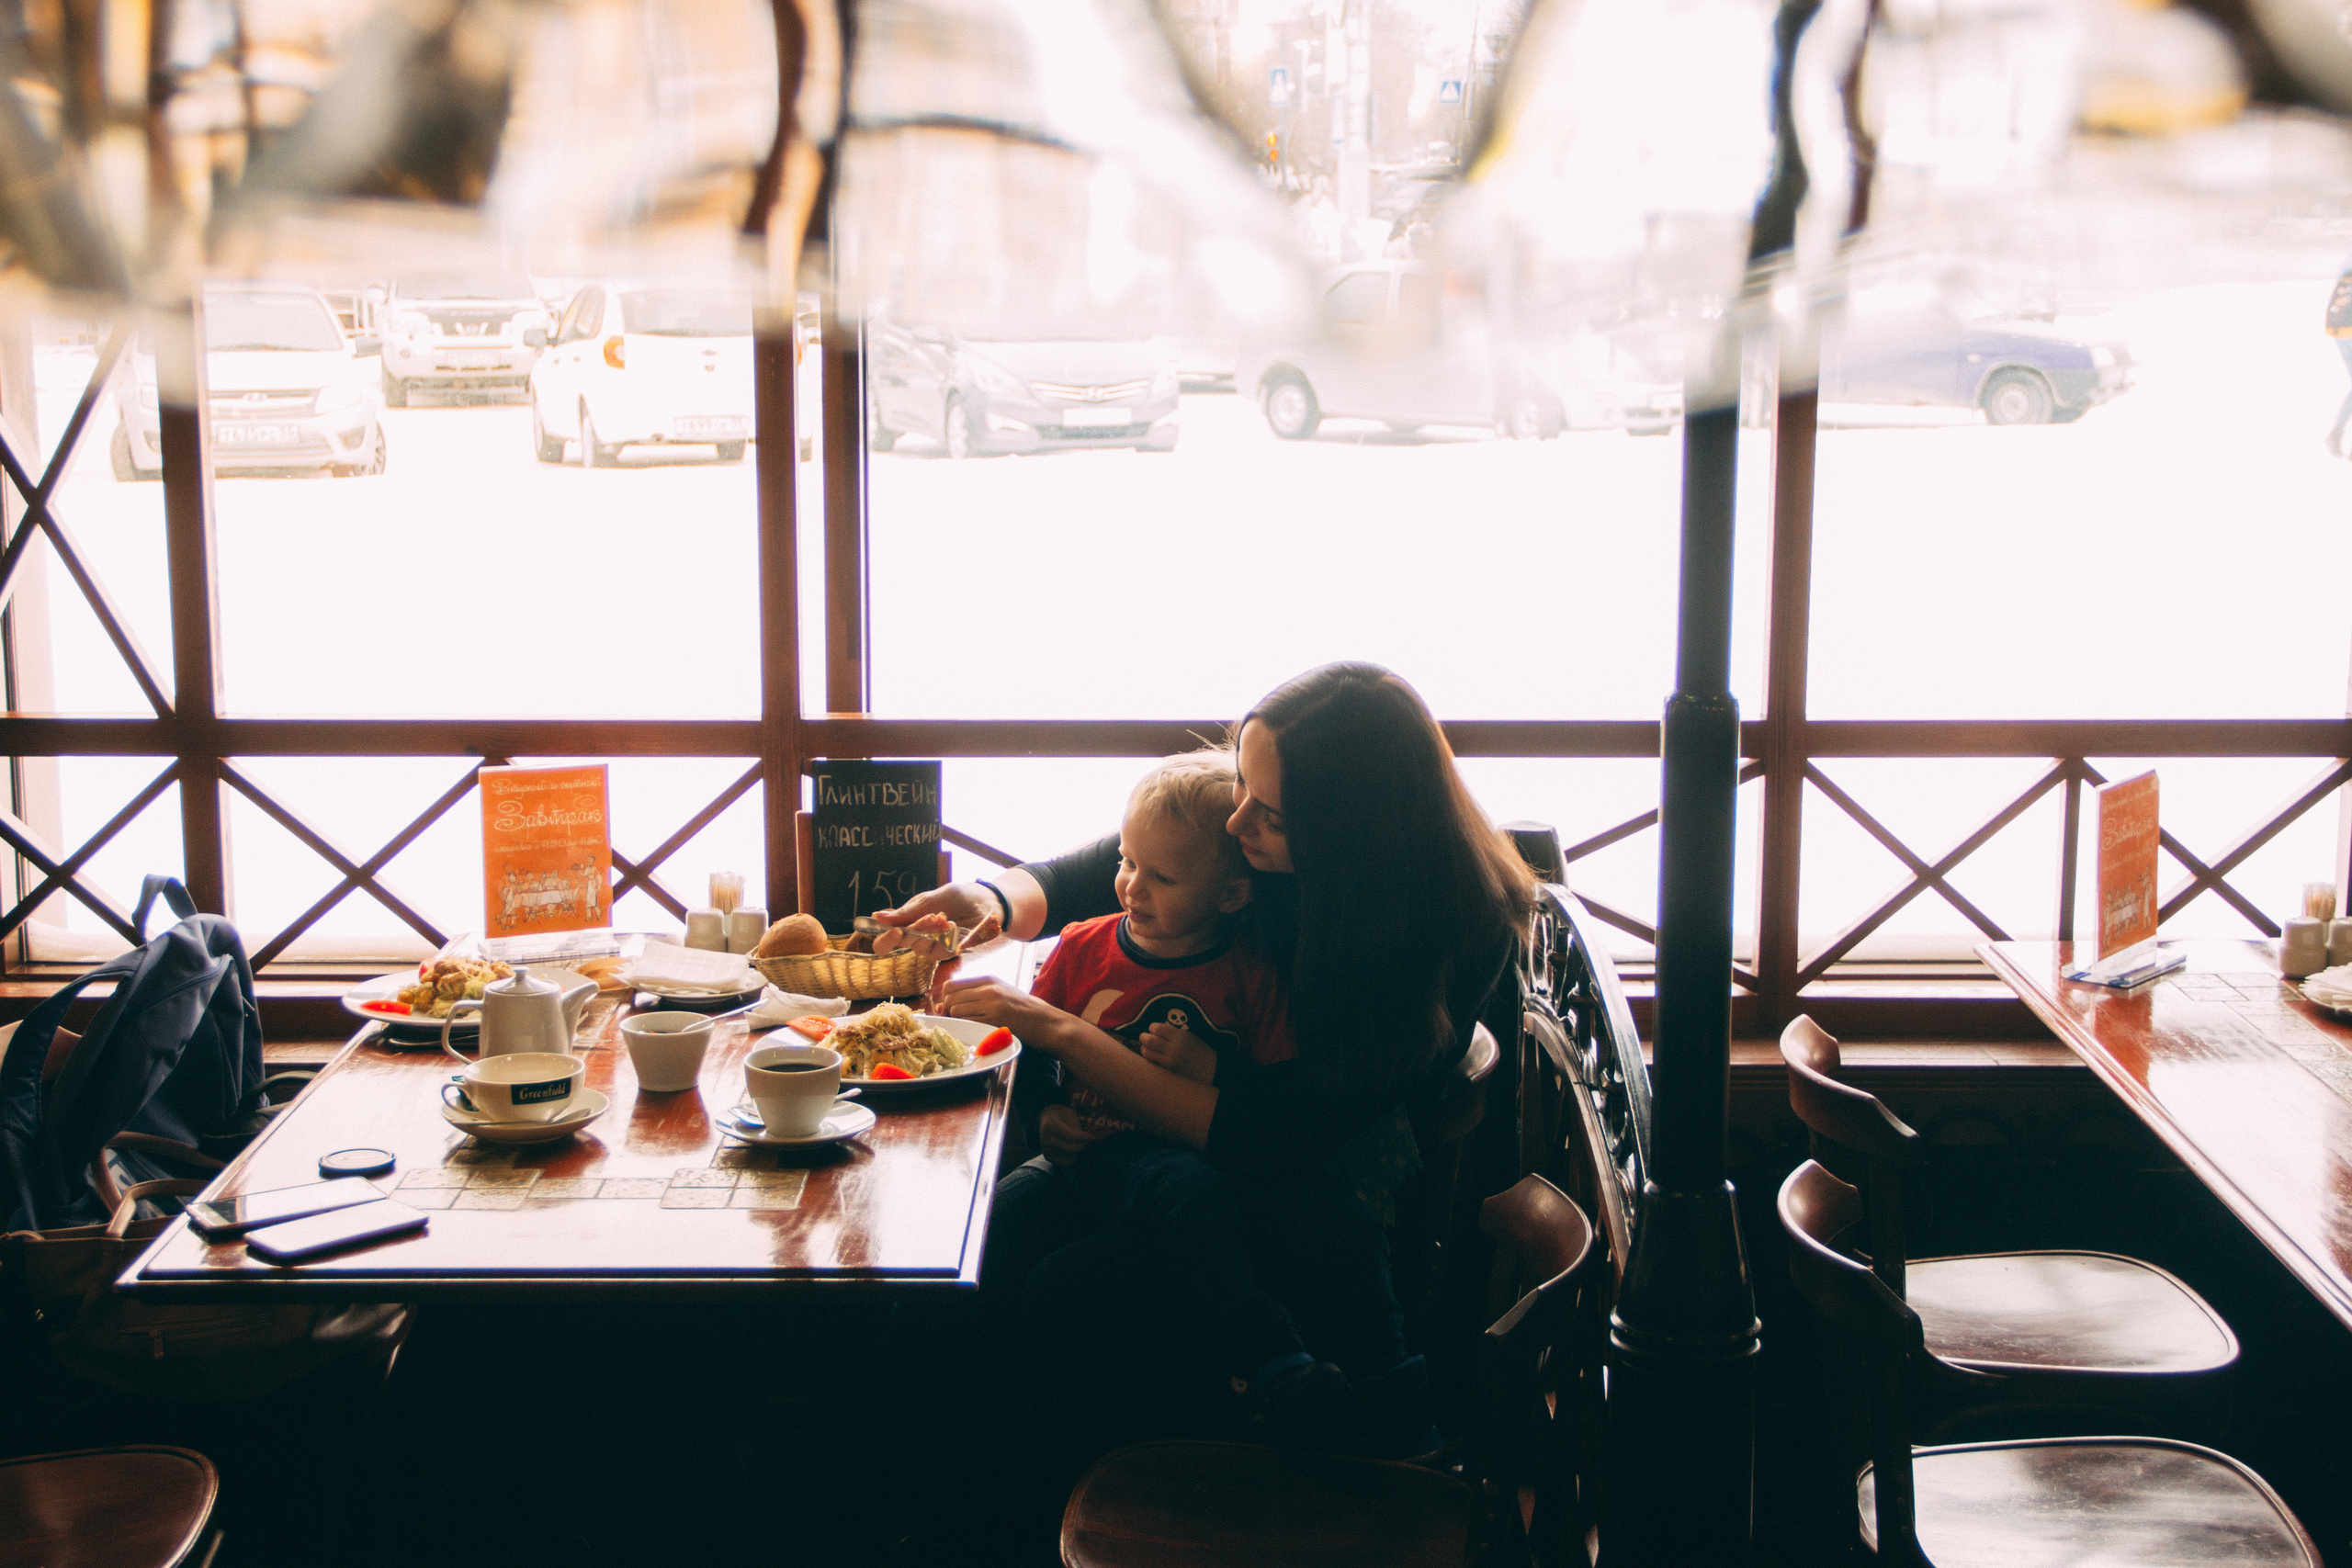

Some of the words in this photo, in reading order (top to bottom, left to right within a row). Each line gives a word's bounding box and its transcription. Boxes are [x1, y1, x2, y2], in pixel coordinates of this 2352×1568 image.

[494, 795, 603, 835] Завтрак
[818, 818, 943, 848] КЛАССЧЕСКИЙ
[519, 1083, 566, 1100] Greenfield
